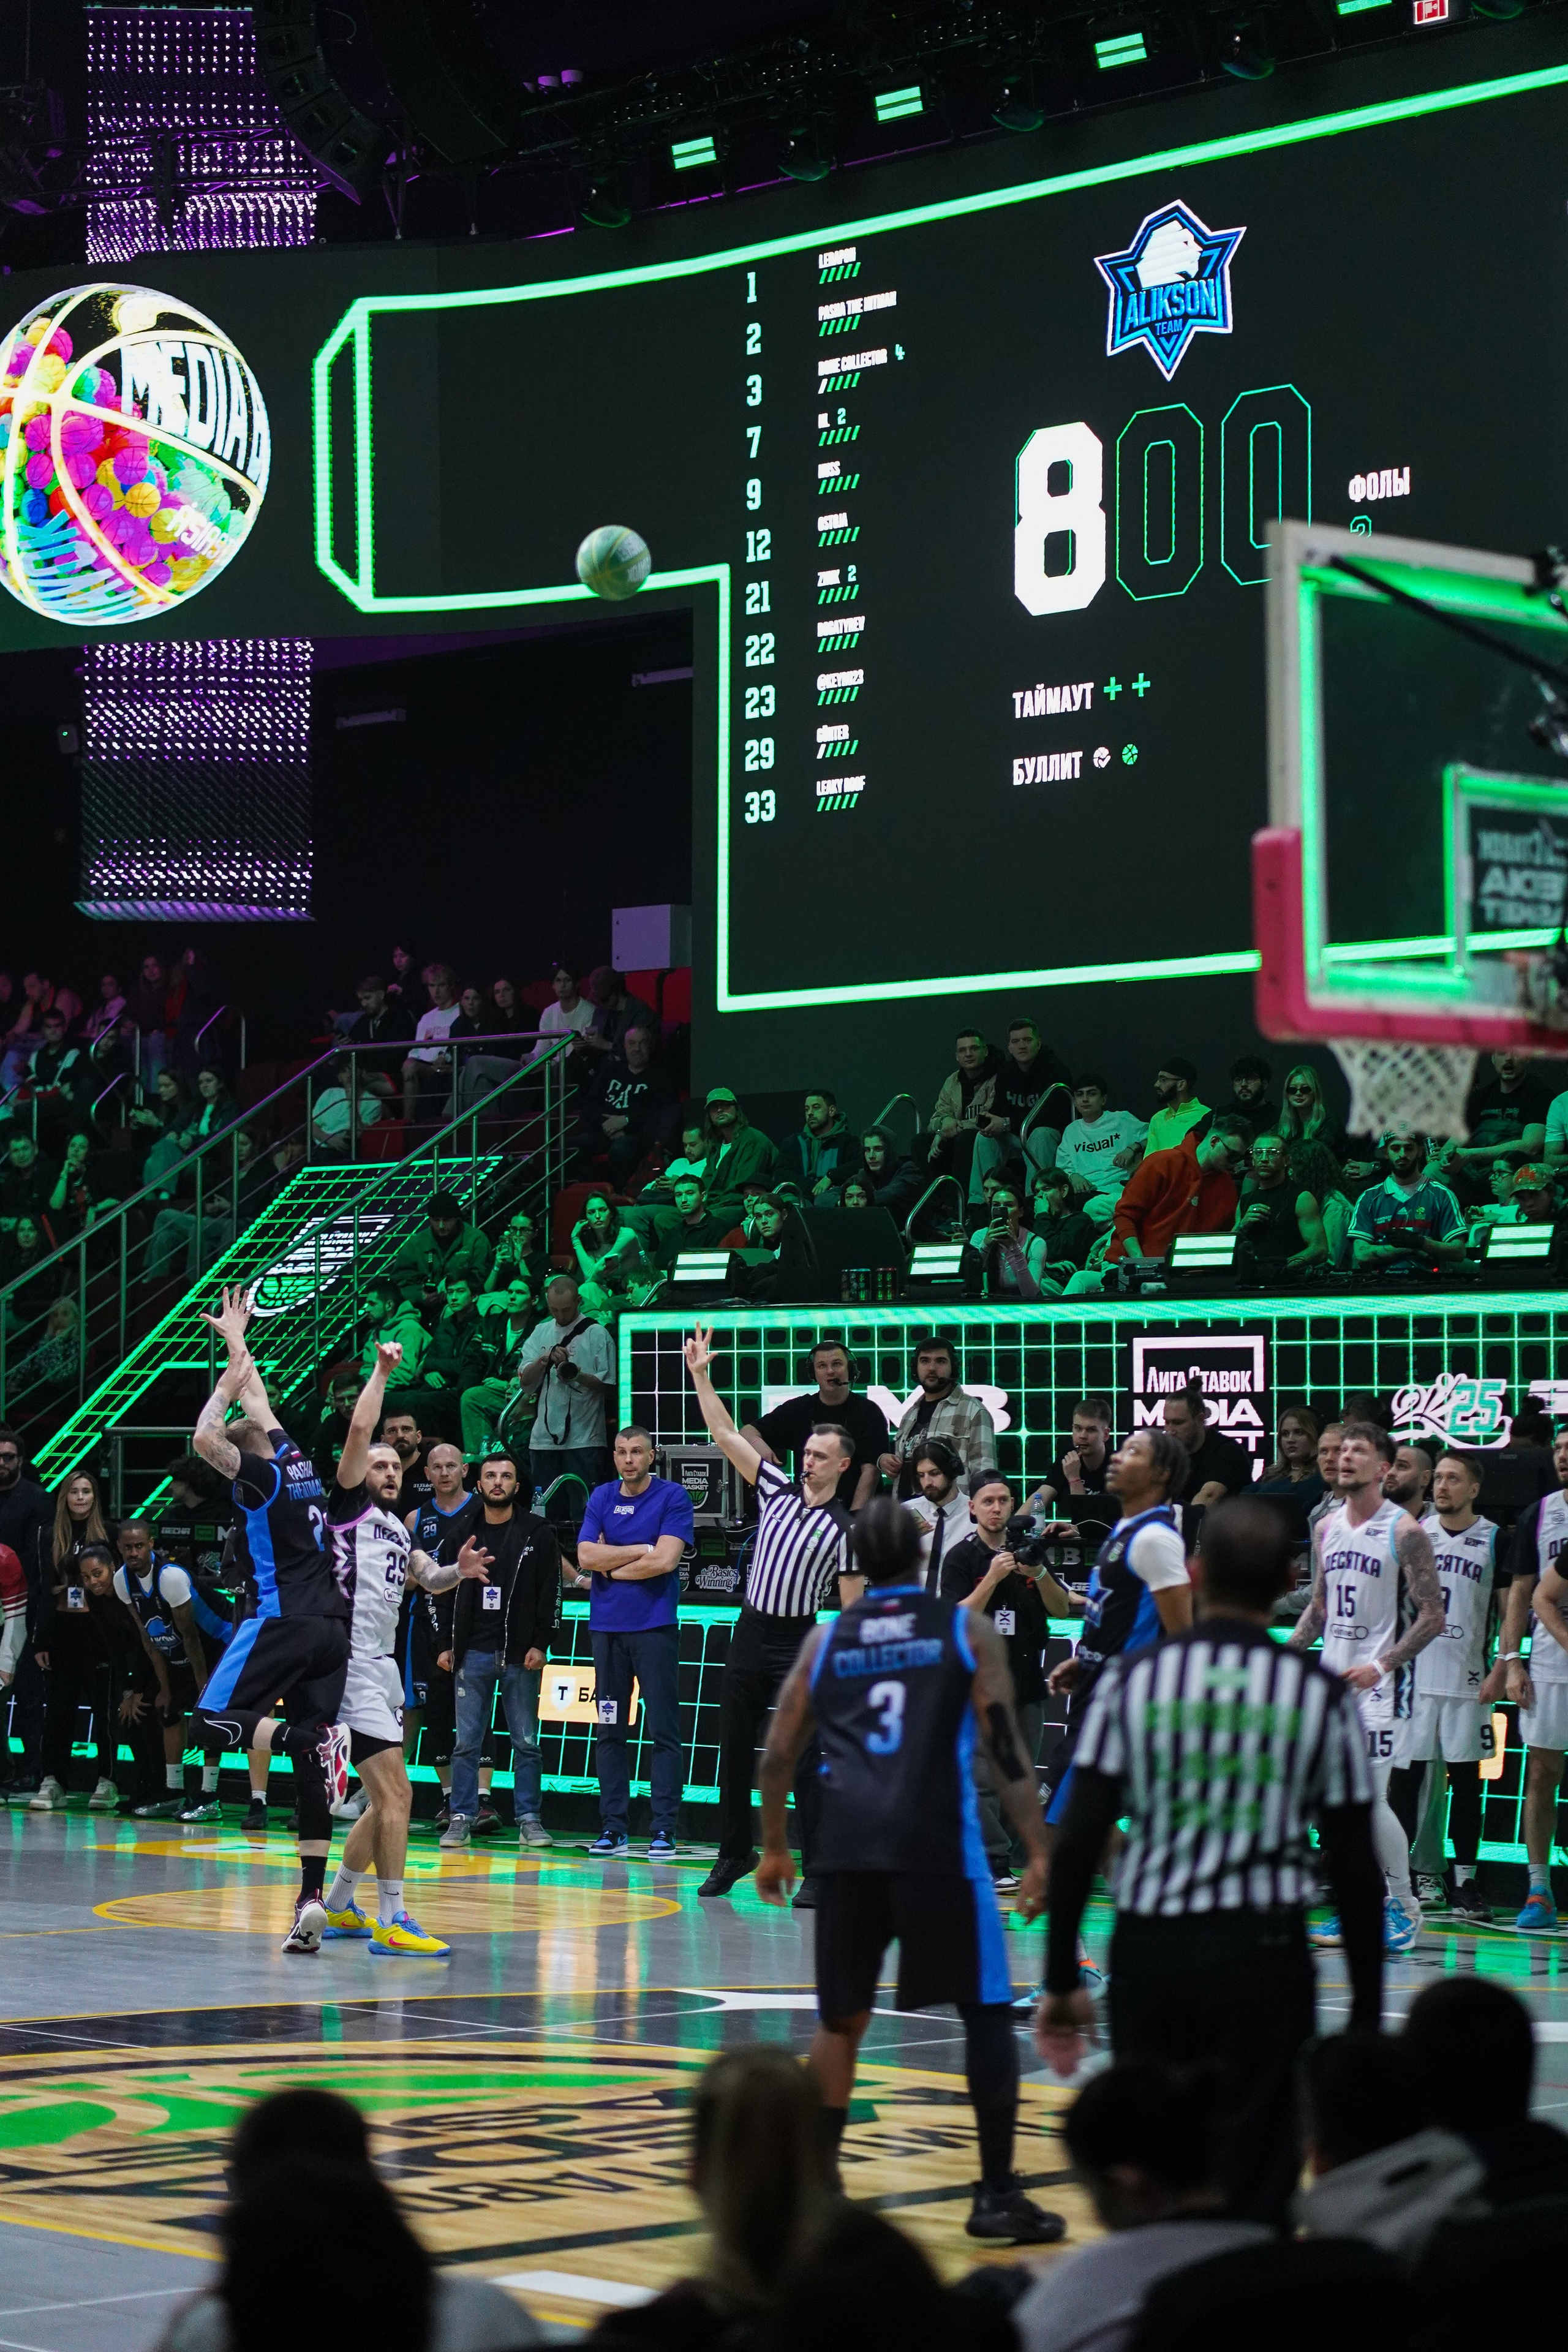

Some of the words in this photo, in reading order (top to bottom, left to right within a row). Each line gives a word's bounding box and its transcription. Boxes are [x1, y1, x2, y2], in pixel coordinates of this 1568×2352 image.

[747, 272, 756, 303] 1
[1125, 279, 1216, 332] ALIKSON
[747, 323, 761, 355] 2
[1155, 318, 1183, 336] TEAM
[841, 349, 888, 371] COLLECTOR
[895, 344, 905, 360] 4
[747, 374, 761, 406] 3
[837, 408, 846, 424] 2
[747, 426, 761, 458] 7
[747, 478, 761, 510] 9
[1349, 467, 1410, 502] ФОЛЫ
[747, 529, 771, 562] 12
[848, 565, 856, 582] 2
[746, 581, 771, 614] 21
[745, 633, 775, 667] 22
[745, 685, 775, 719] 23
[1012, 683, 1094, 718] ТАЙМАУТ
[745, 737, 774, 771] 29
[1013, 751, 1083, 785] БУЛЛИТ
[745, 790, 775, 823] 33
[1133, 1398, 1264, 1427] MDIA
[286, 1460, 314, 1480] PASHA
[308, 1504, 326, 1551] 2
[423, 1524, 437, 1539] 29
[709, 1566, 739, 1578] Basics
[1434, 1554, 1482, 1583] СЯТКА
[1336, 1585, 1357, 1618] 15
[833, 1638, 943, 1678] COLLECTOR
[558, 1686, 568, 1701] Т
[865, 1680, 905, 1754] 3
[1368, 1730, 1393, 1757] 15
[1480, 1724, 1496, 1750] 9
